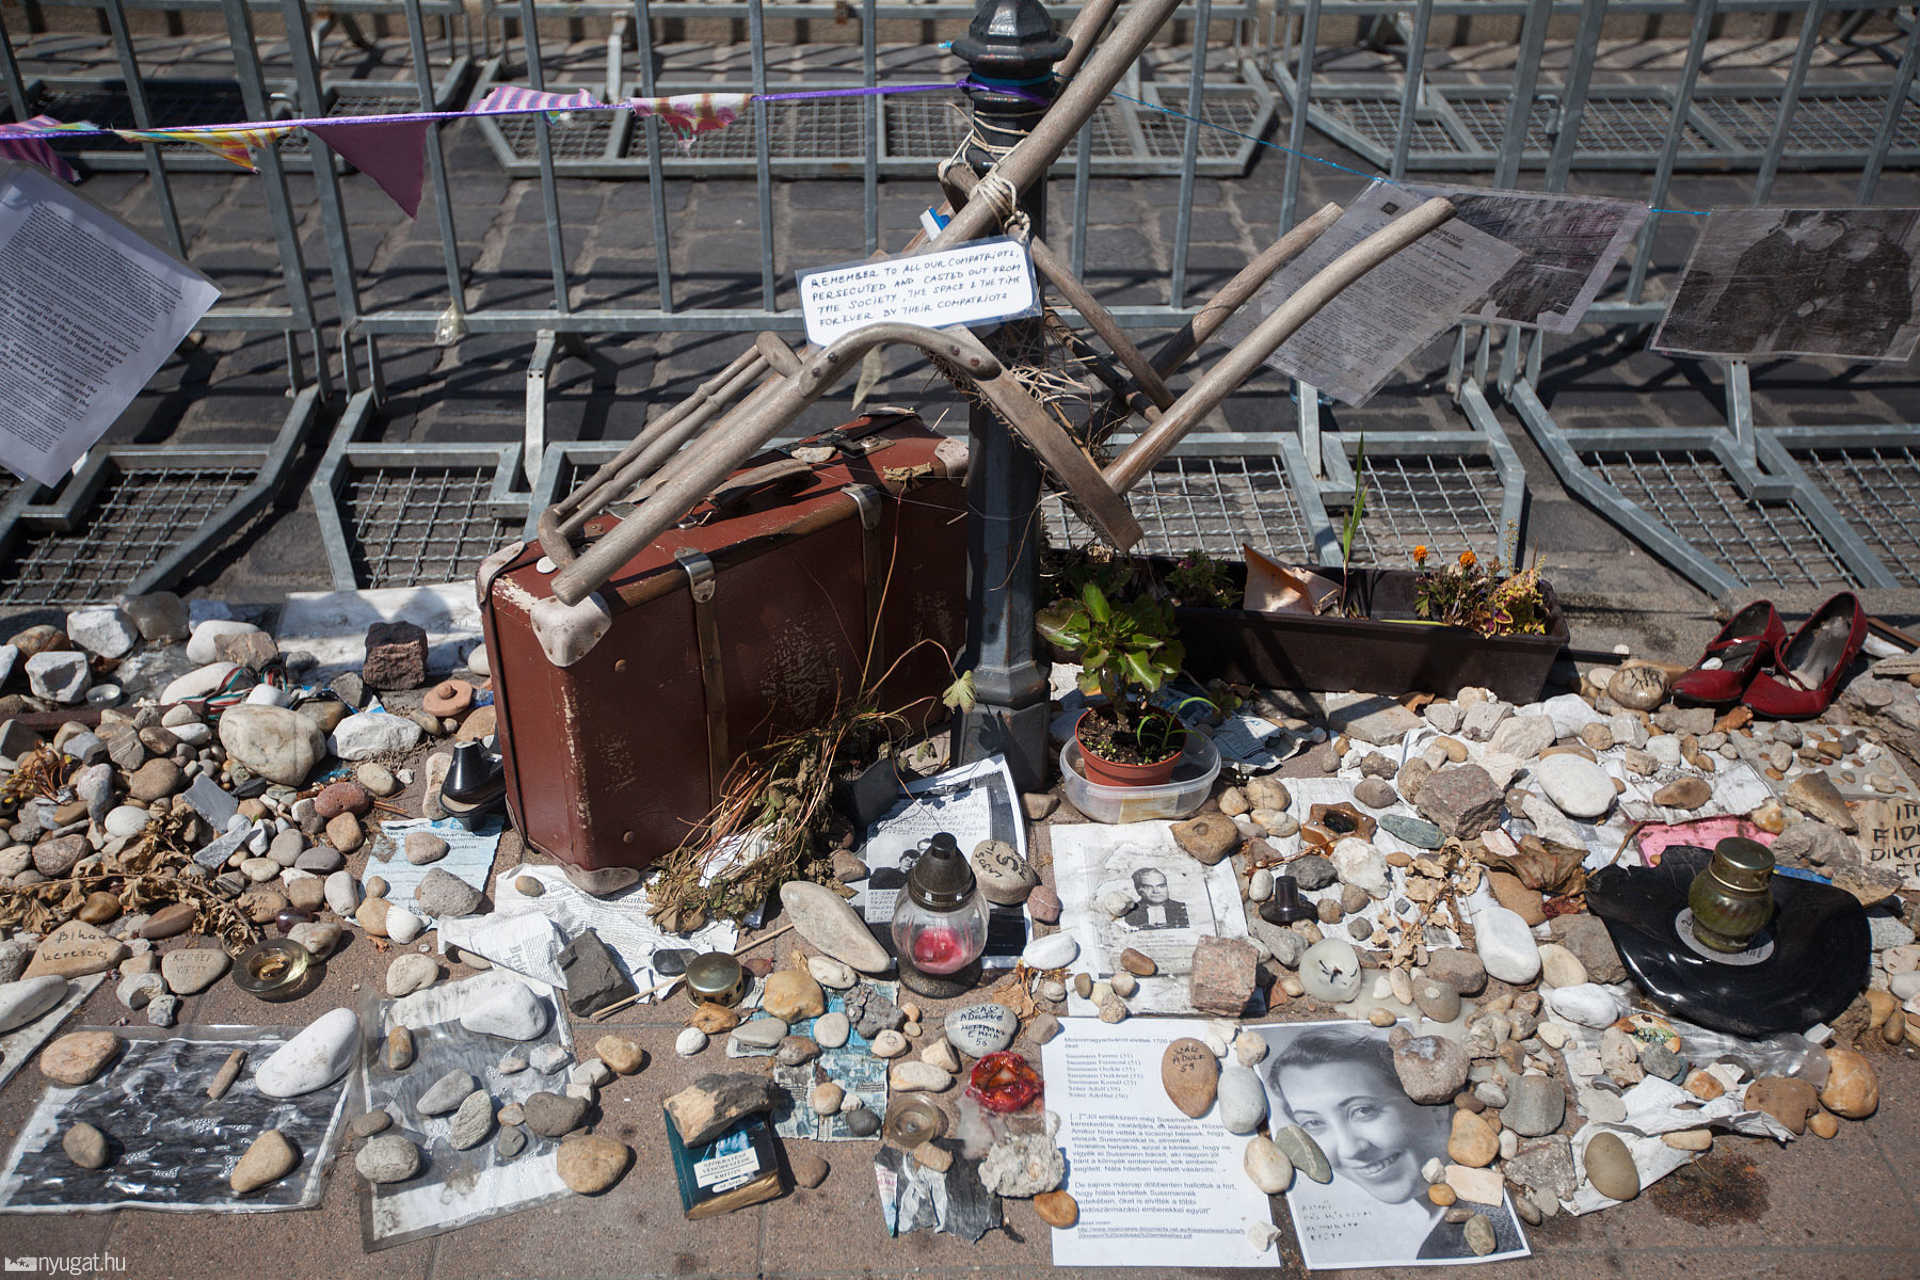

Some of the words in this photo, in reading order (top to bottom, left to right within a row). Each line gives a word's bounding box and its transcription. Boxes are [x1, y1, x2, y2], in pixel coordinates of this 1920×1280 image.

[811, 270, 879, 288] REMEMBER
[885, 267, 897, 276] TO
[903, 264, 920, 273] ALL
[924, 261, 944, 269] OUR
[813, 283, 886, 302] PERSECUTED
[894, 278, 914, 287] AND
[924, 271, 963, 284] CASTED
[968, 268, 987, 277] OUT
[993, 265, 1021, 273] FROM
[817, 304, 839, 314] THE
[908, 288, 926, 298] THE
[933, 283, 963, 294] SPACE
[981, 278, 995, 287] THE
[999, 275, 1021, 285] TIME
[883, 308, 897, 318] BY
[903, 304, 933, 315] THEIR
